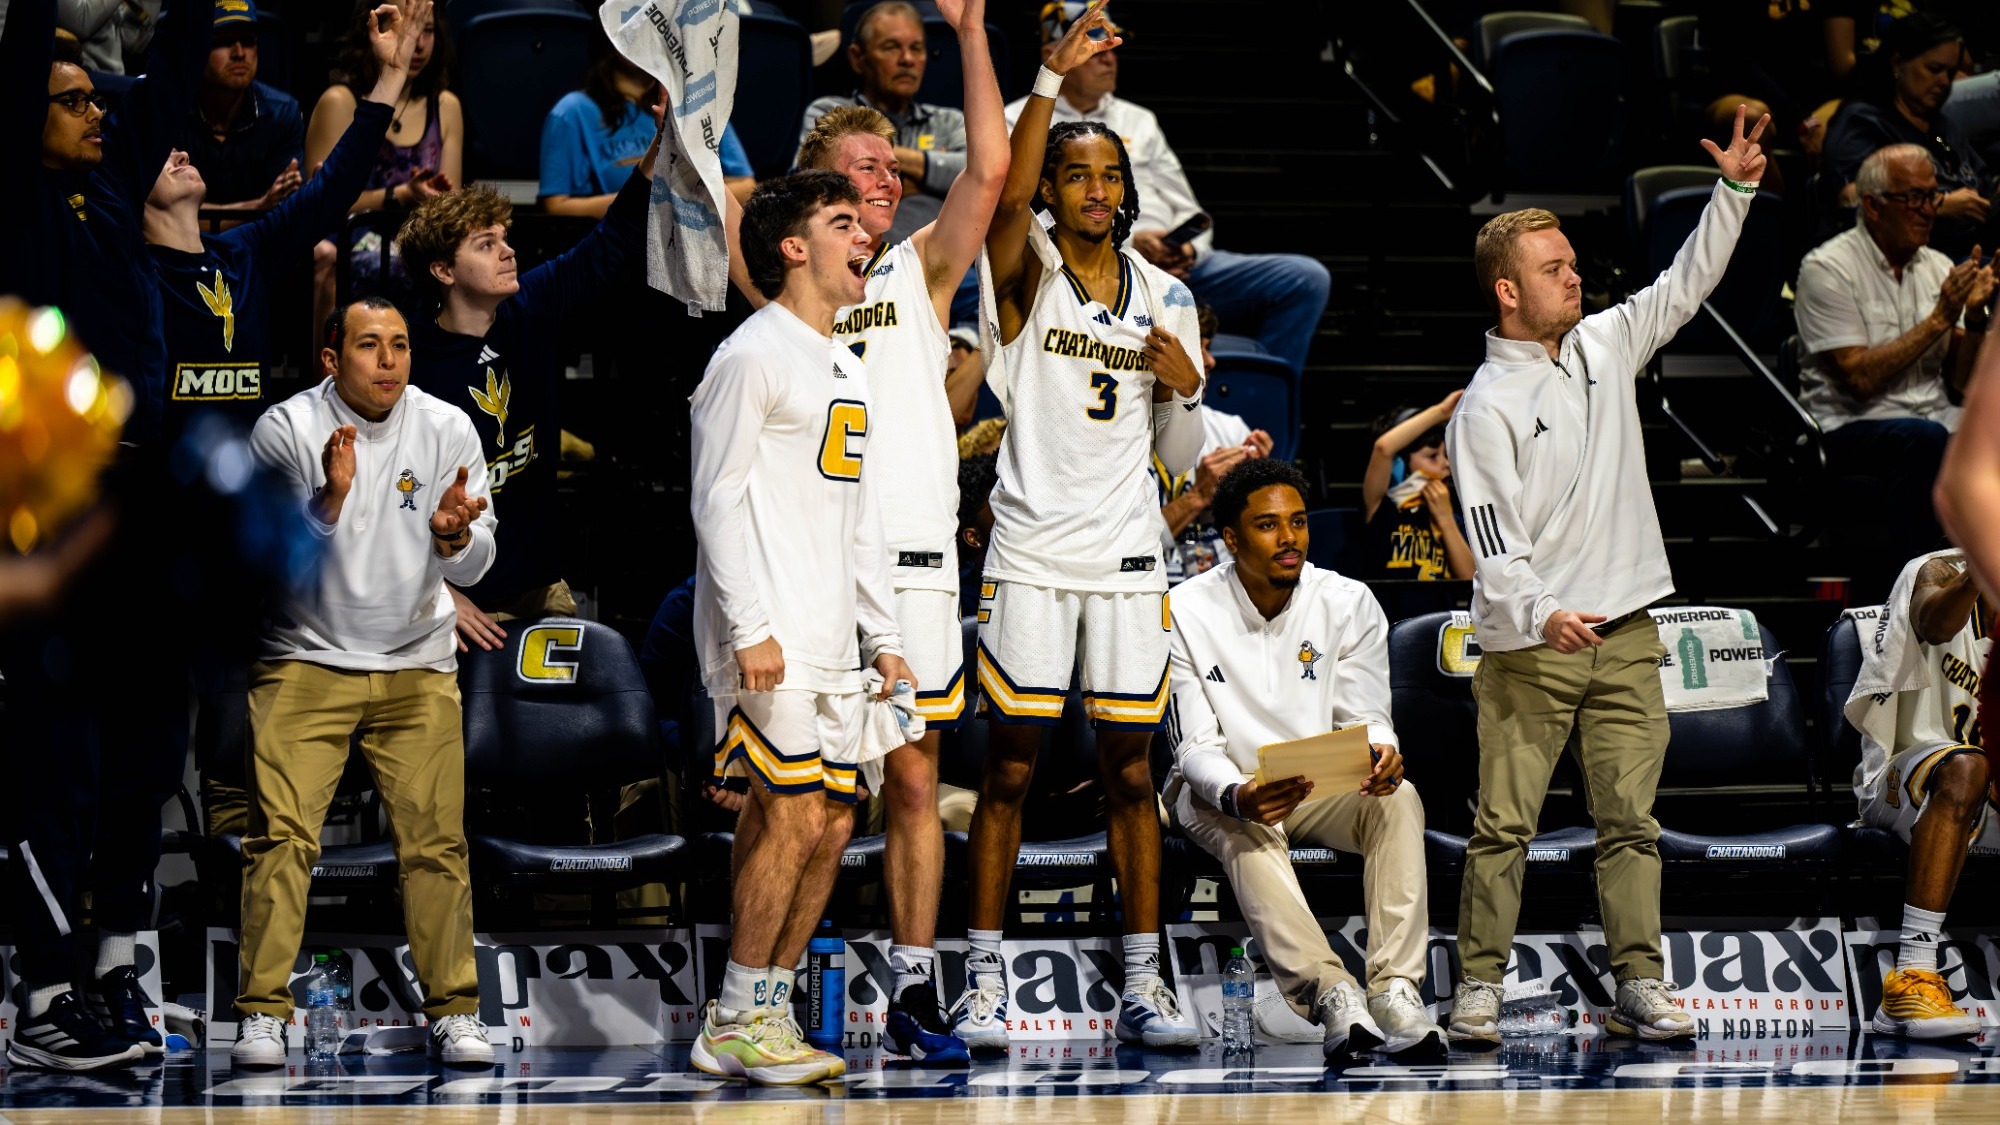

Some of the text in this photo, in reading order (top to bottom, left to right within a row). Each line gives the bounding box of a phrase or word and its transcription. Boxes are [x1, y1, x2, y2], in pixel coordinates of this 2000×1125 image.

[179, 369, 260, 394] MOCS
[1087, 371, 1119, 421] 3
[817, 398, 867, 482] C
[517, 624, 585, 684] C
[1686, 640, 1700, 686] POWERADE
[551, 857, 631, 871] CHATTANOOGA
[1016, 853, 1096, 866] CHATTANOOGA
[1707, 845, 1784, 858] CHATTANOOGA
[810, 954, 821, 1029] POWERADE
[1774, 998, 1844, 1011] GROUP
